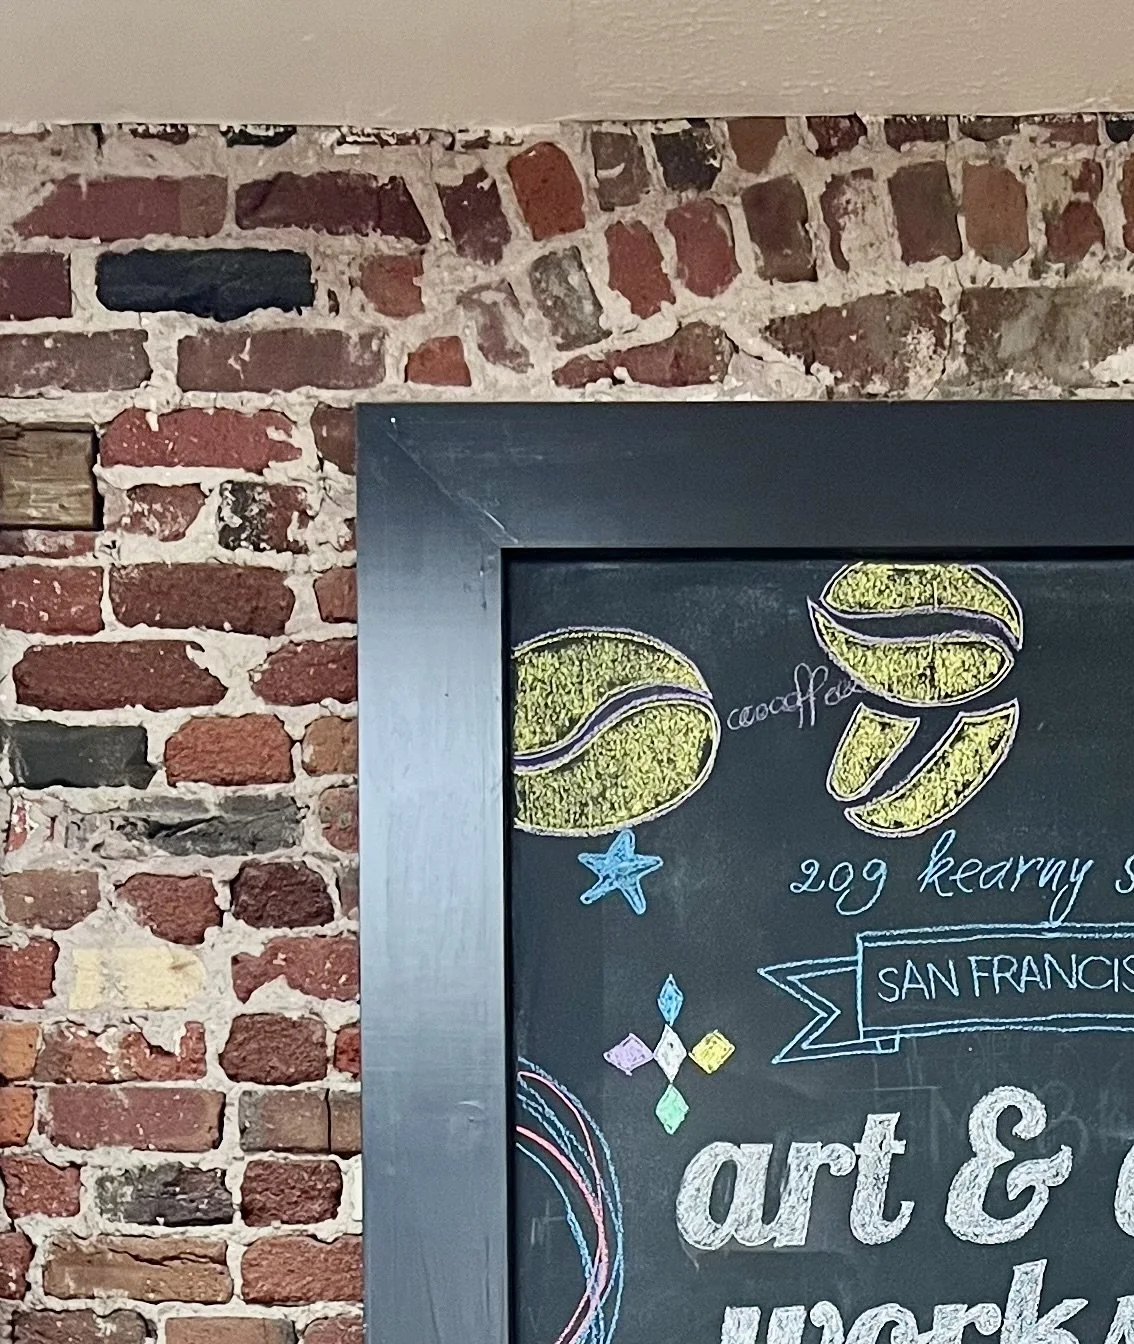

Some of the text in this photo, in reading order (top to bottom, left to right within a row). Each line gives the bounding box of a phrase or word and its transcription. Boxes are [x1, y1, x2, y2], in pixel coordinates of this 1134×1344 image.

[790, 858, 887, 916] 209
[917, 829, 1094, 924] kearny
[877, 956, 959, 1002] SAN
[676, 1110, 914, 1250] art
[944, 1085, 1073, 1245] &
